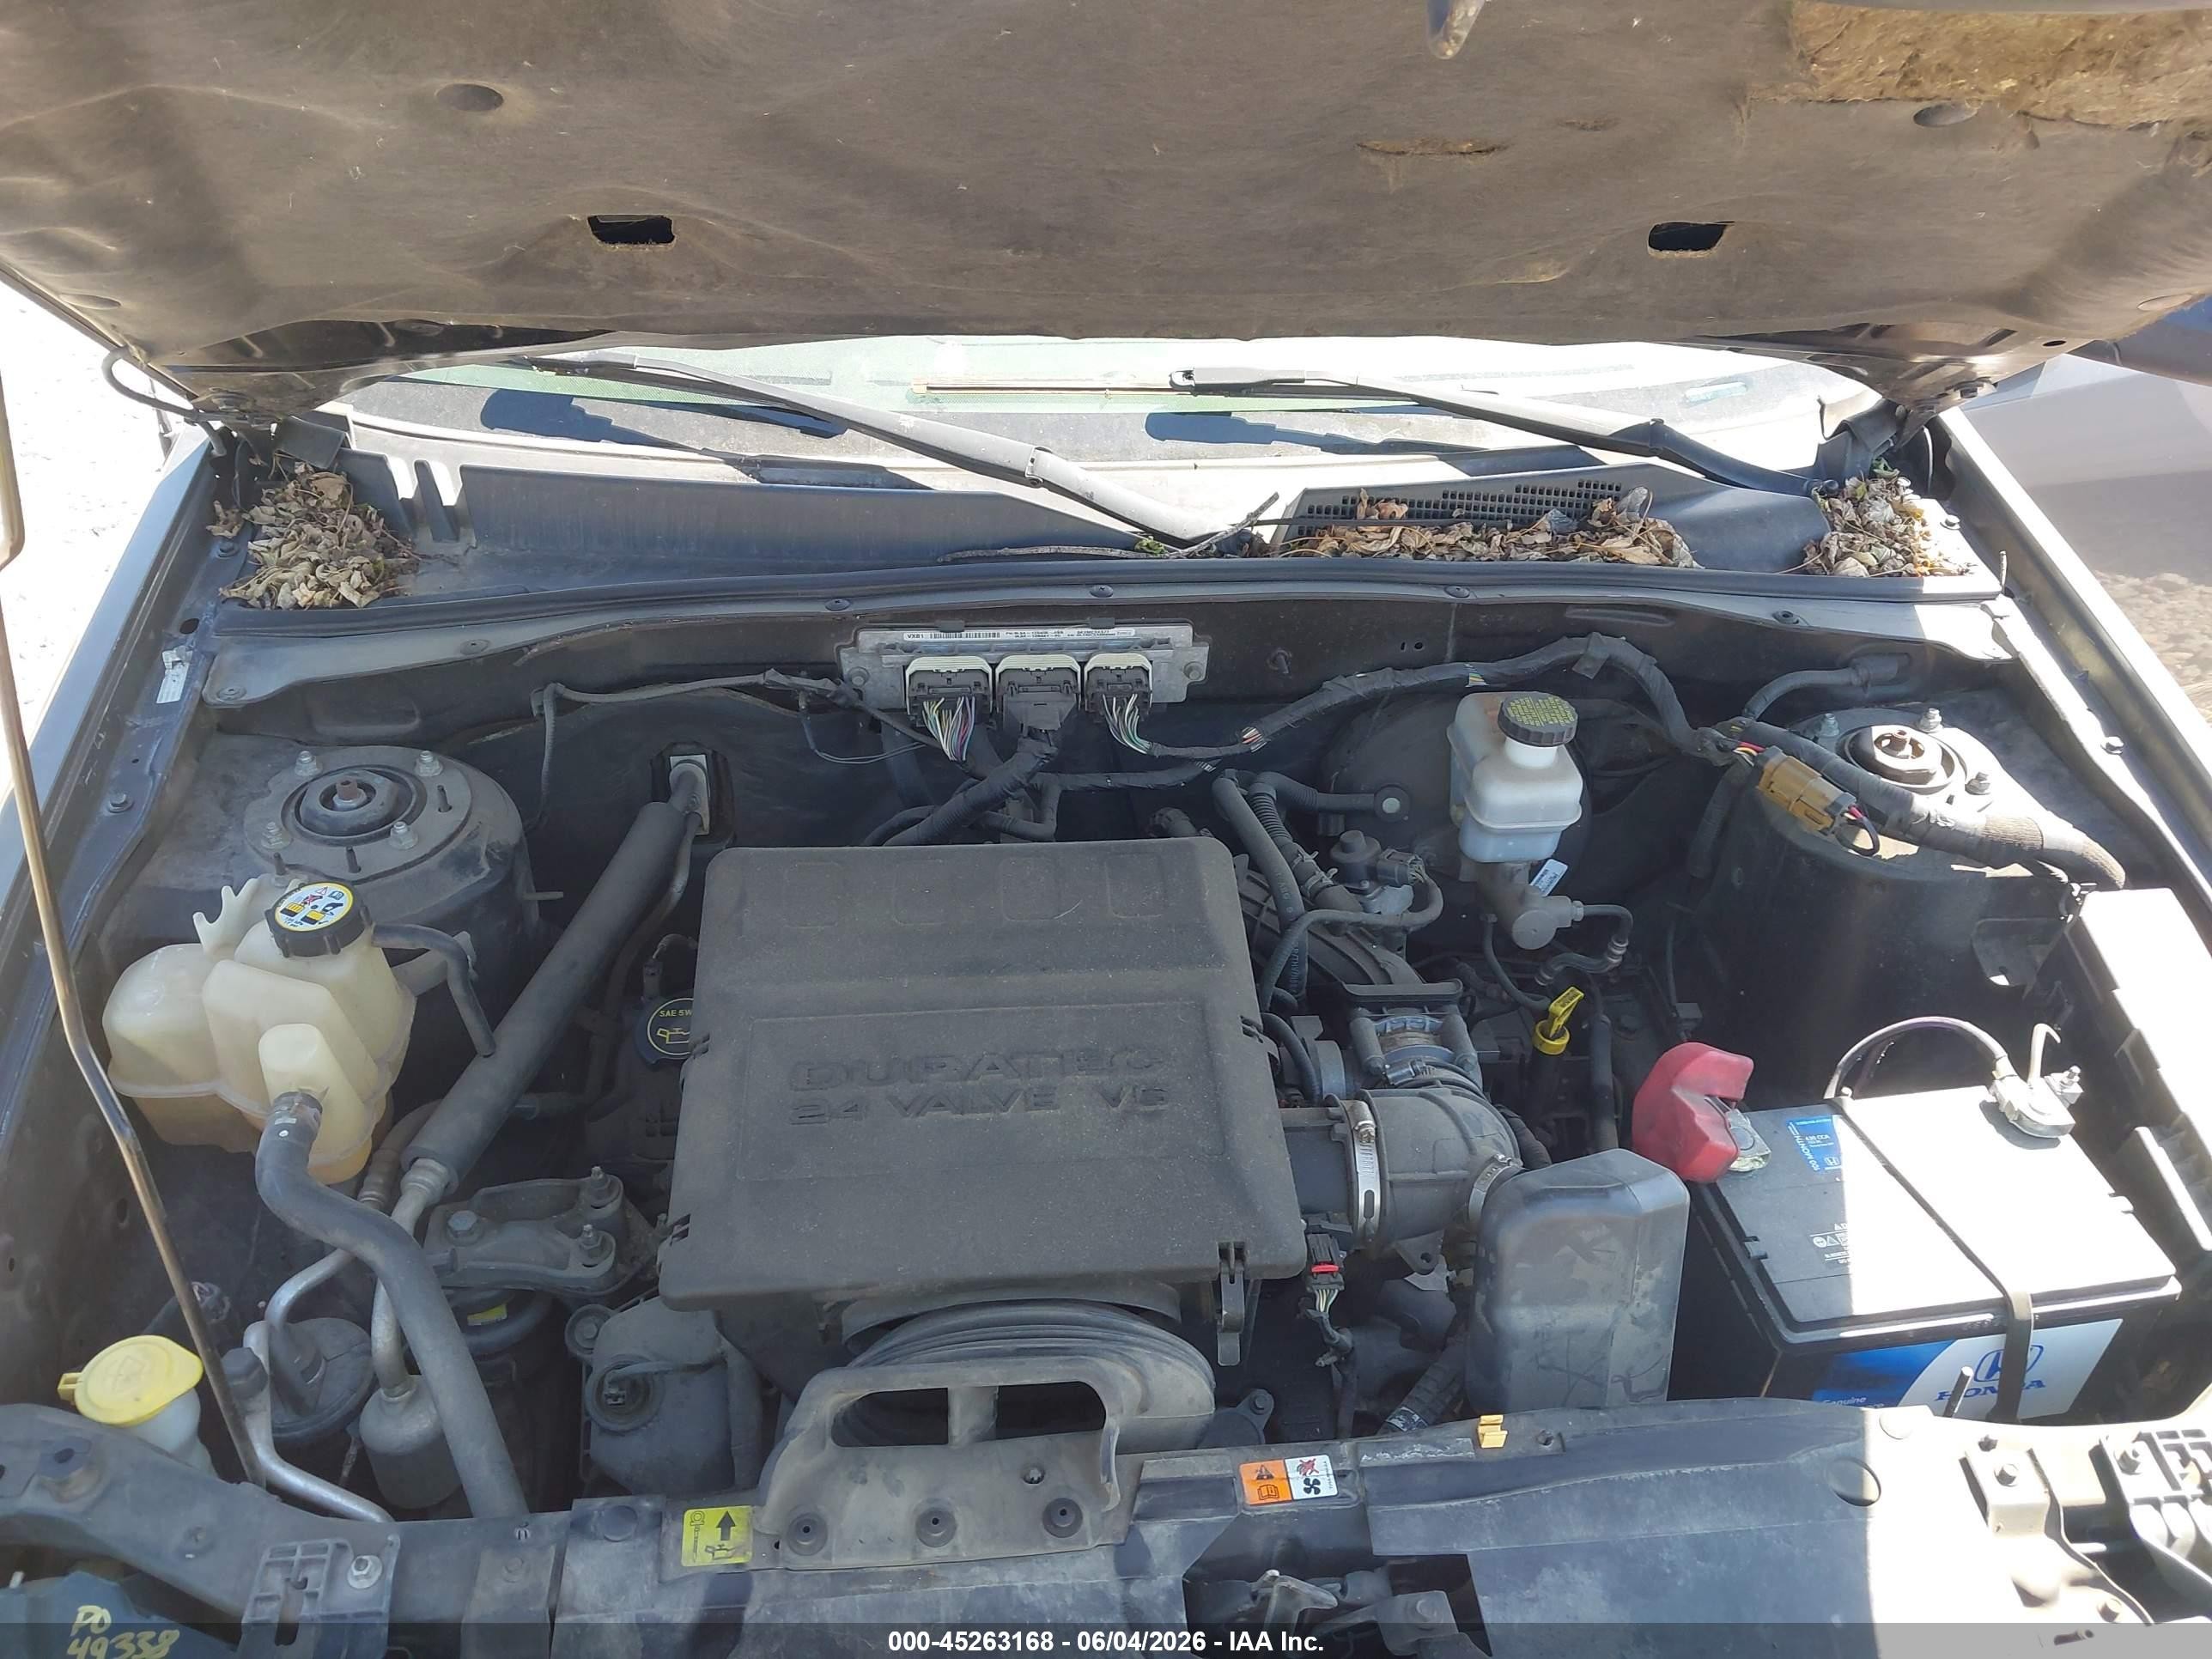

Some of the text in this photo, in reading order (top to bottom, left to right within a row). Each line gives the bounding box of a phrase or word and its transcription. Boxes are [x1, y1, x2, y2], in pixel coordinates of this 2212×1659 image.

[789, 1046, 1165, 1091] DURATEC
[788, 1083, 1169, 1126] 24 VALVE V6
[1935, 1380, 2045, 1401] HONA
